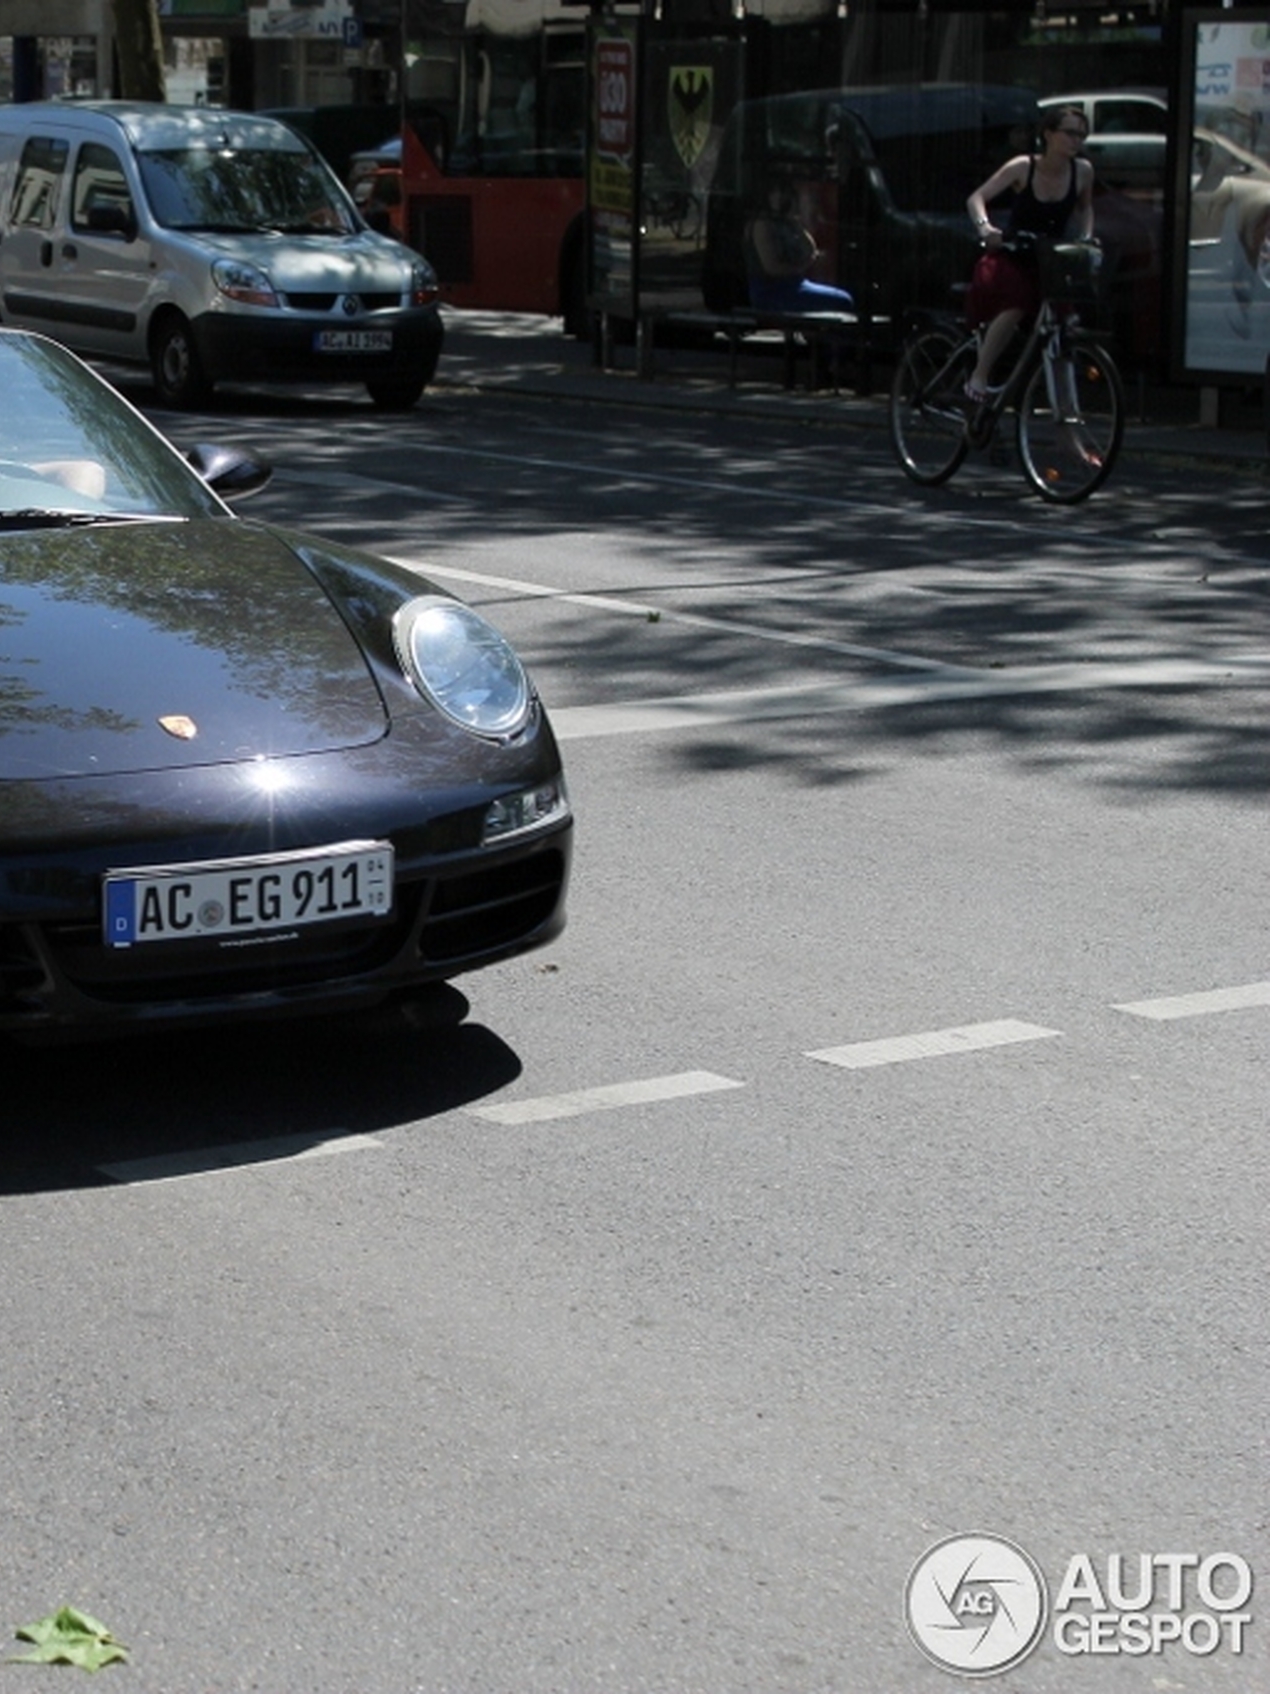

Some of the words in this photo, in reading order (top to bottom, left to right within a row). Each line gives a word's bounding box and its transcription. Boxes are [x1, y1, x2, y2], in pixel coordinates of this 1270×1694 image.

[346, 20, 359, 44] P
[139, 883, 193, 933] AC
[230, 875, 281, 925] EG
[292, 862, 363, 917] 911
[116, 917, 128, 931] D
